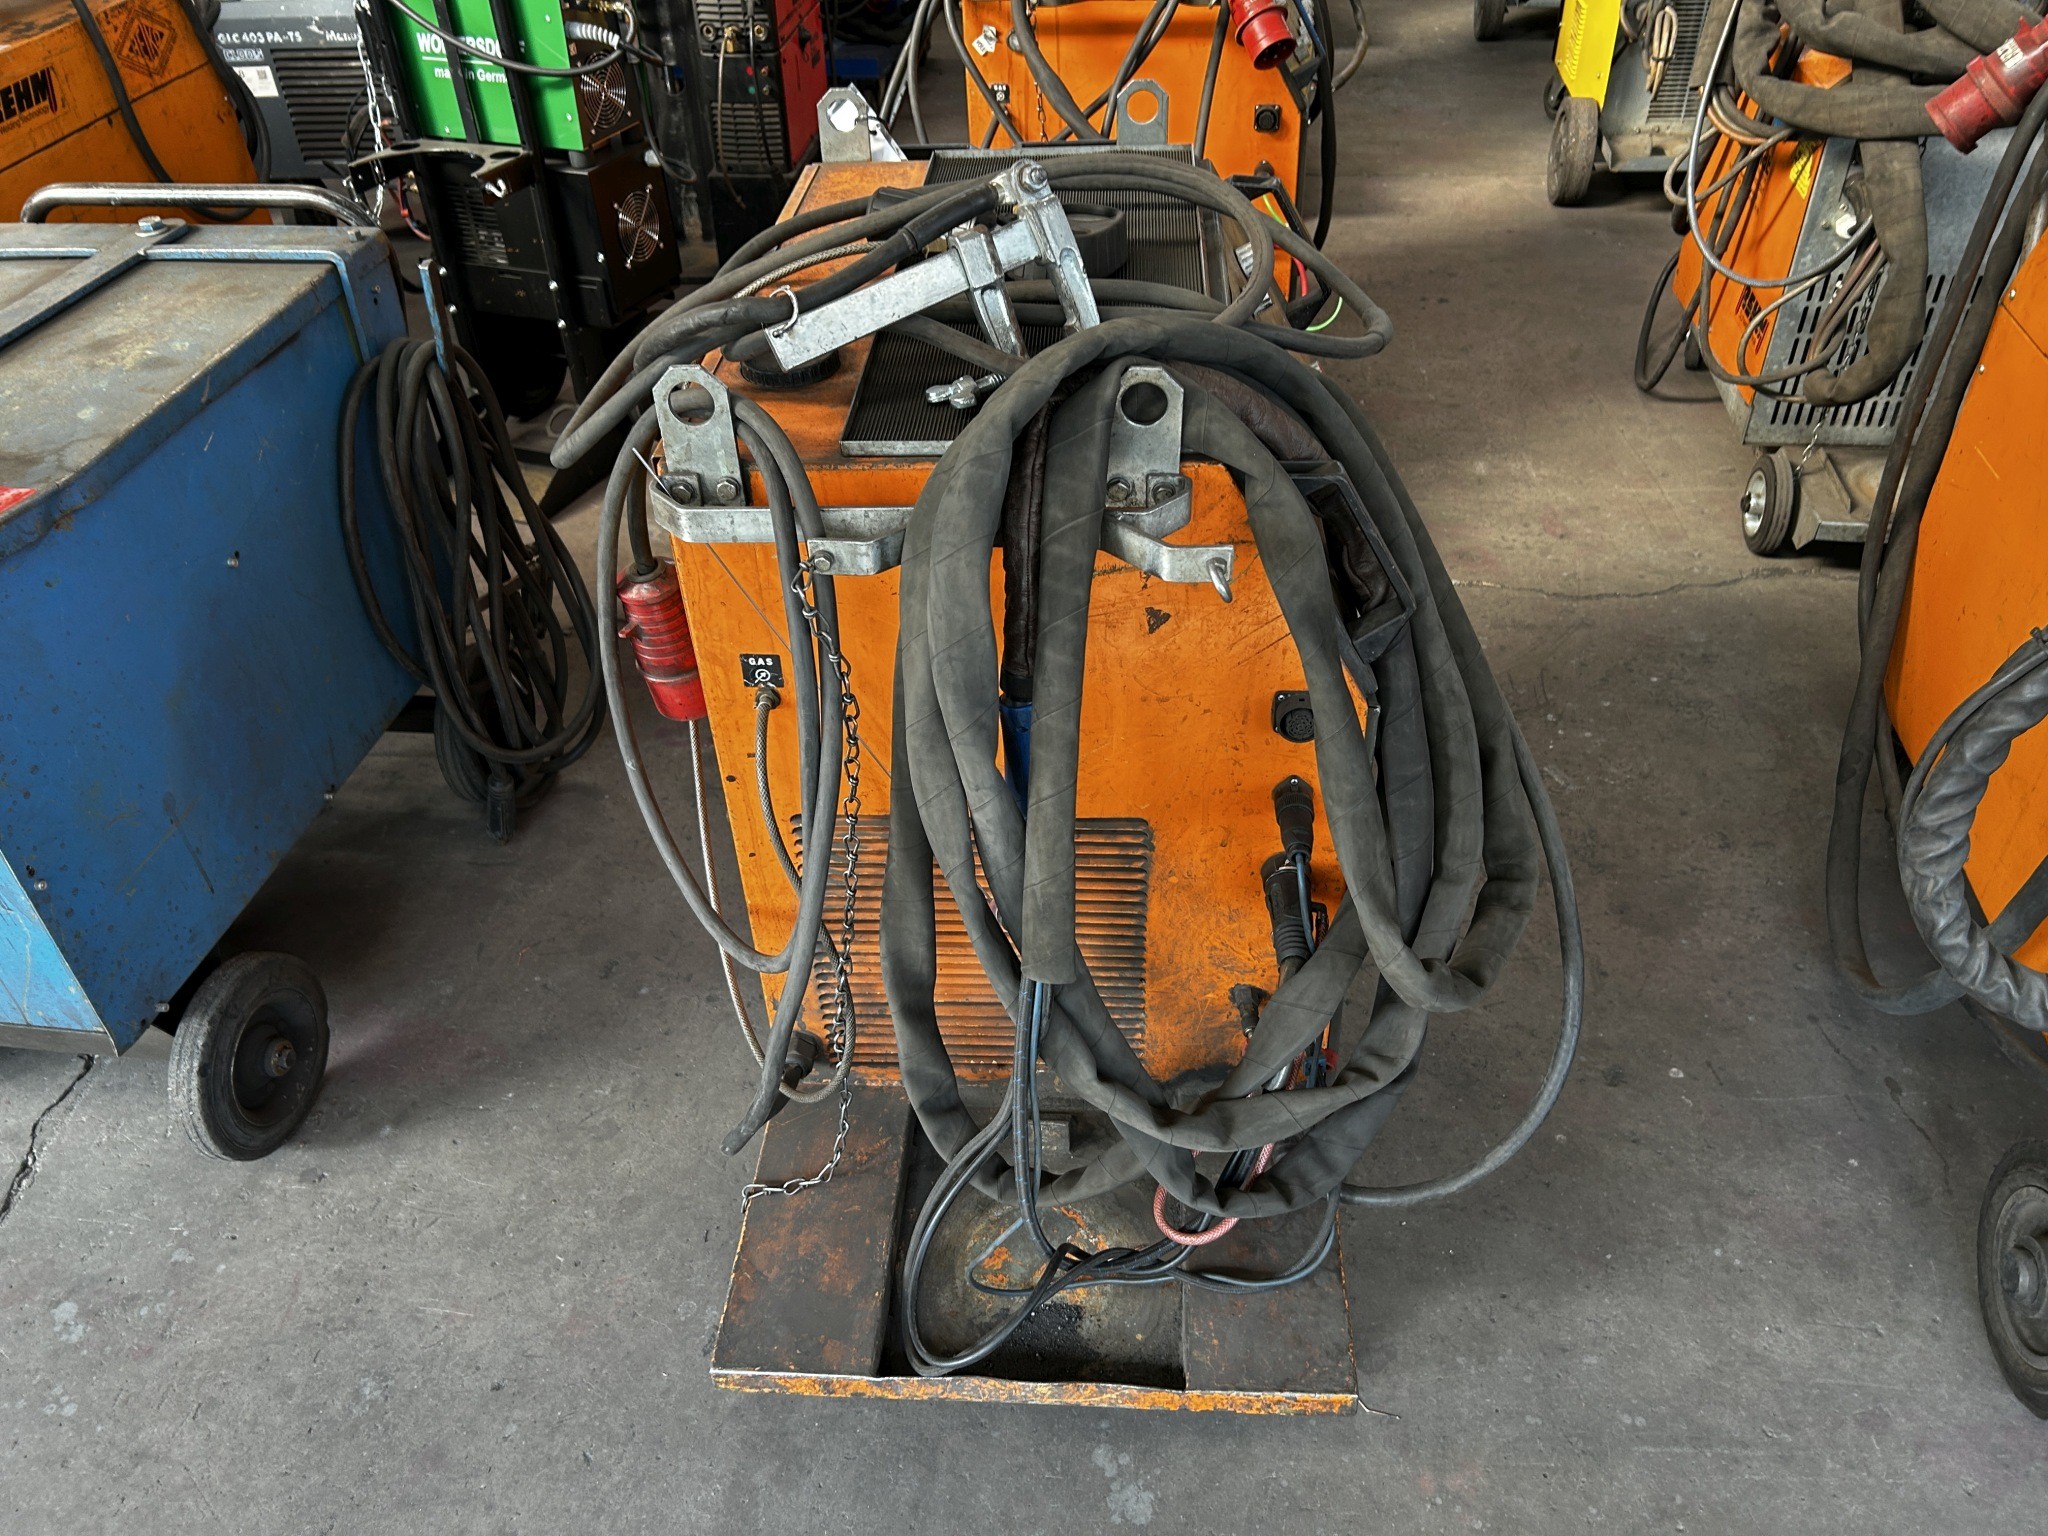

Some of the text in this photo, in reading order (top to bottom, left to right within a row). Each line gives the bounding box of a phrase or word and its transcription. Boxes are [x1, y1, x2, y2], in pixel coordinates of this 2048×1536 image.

[476, 68, 507, 84] Germ
[0, 67, 49, 123] EHM
[748, 657, 773, 666] GAS
